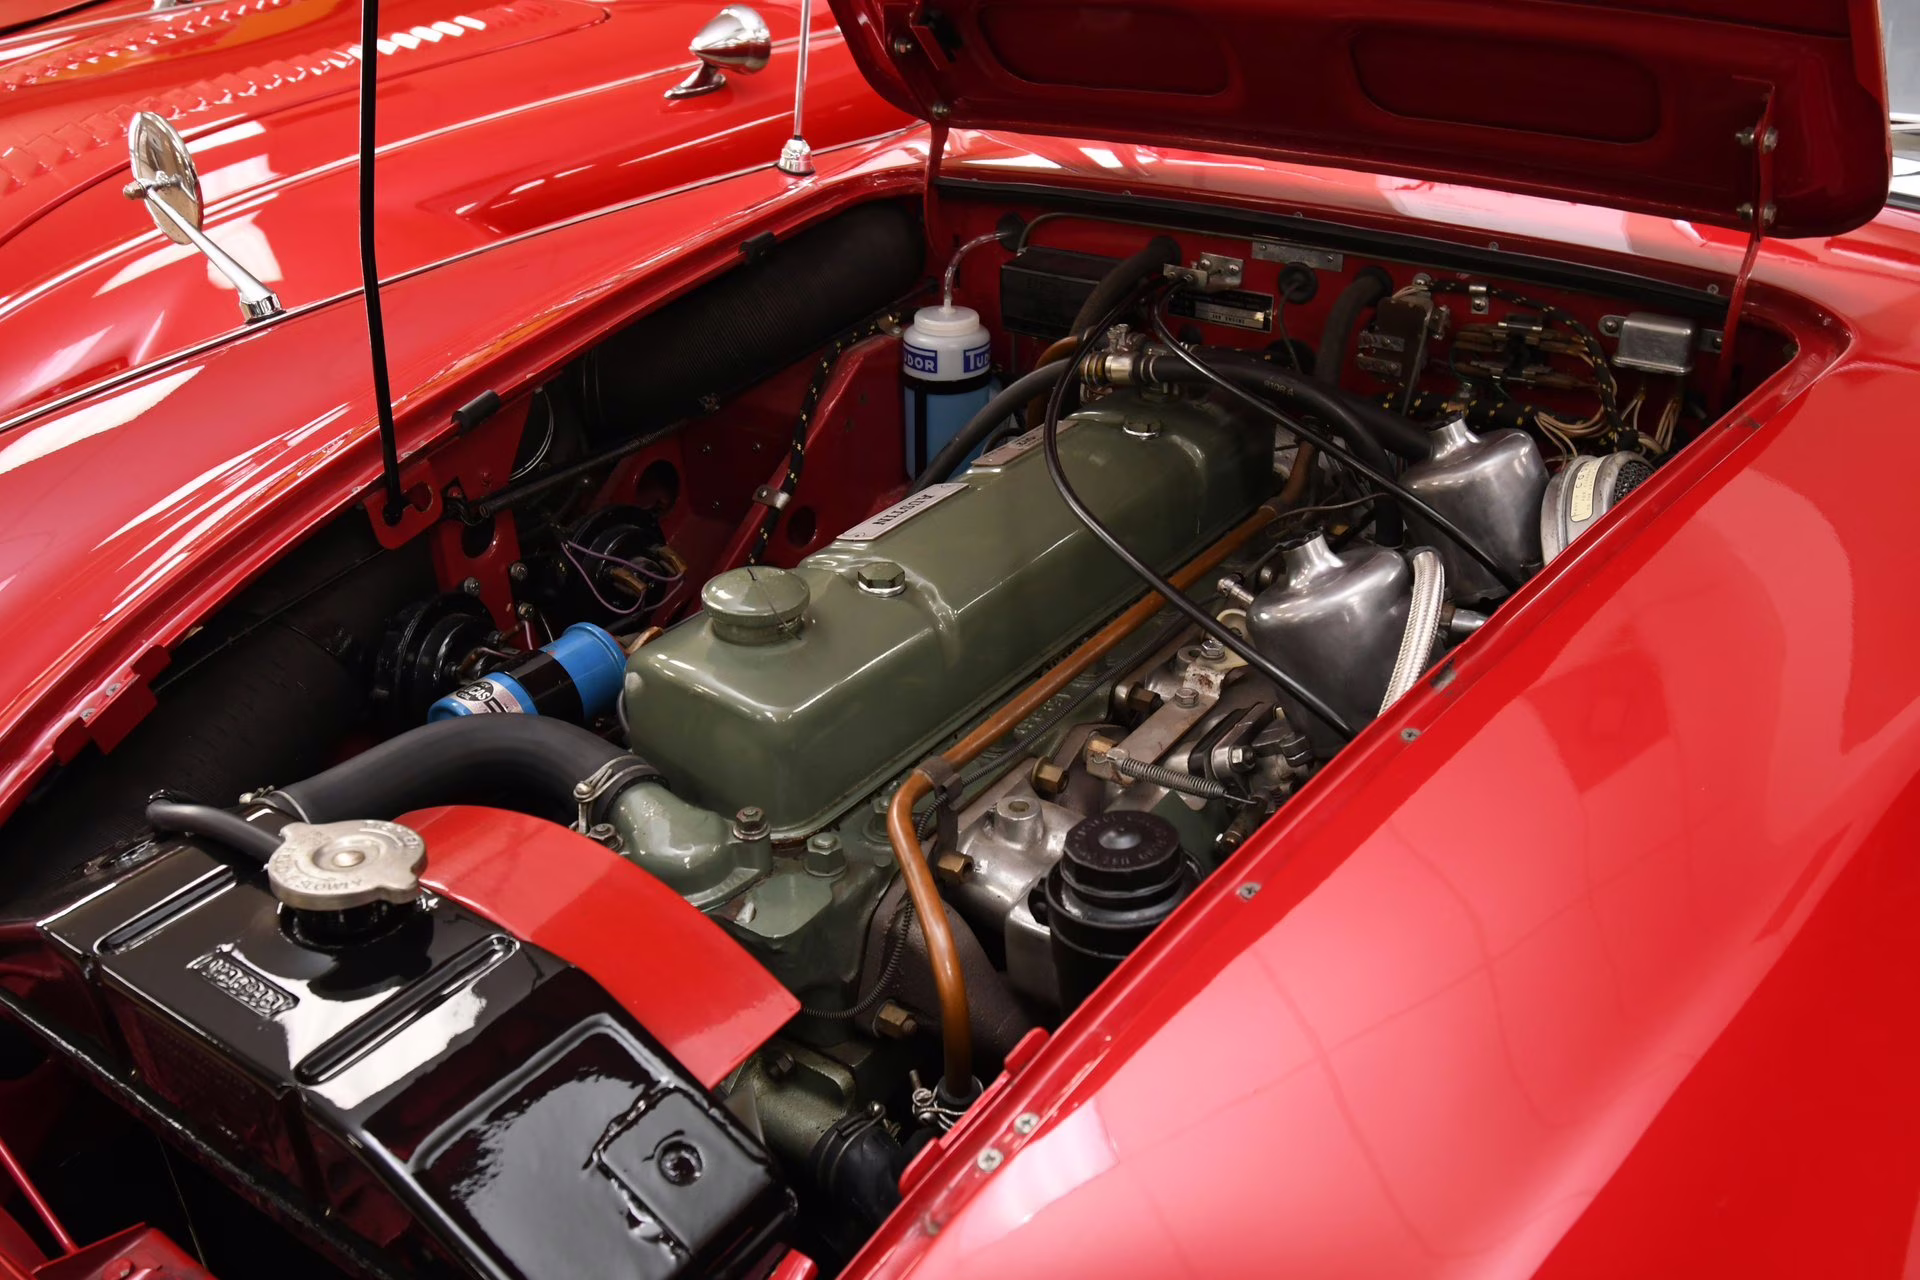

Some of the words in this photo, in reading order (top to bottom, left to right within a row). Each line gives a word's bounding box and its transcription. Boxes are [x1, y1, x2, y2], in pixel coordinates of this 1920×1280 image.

[903, 343, 936, 371] UDOR
[965, 344, 991, 370] TUD
[872, 493, 935, 526] AUSTIN
